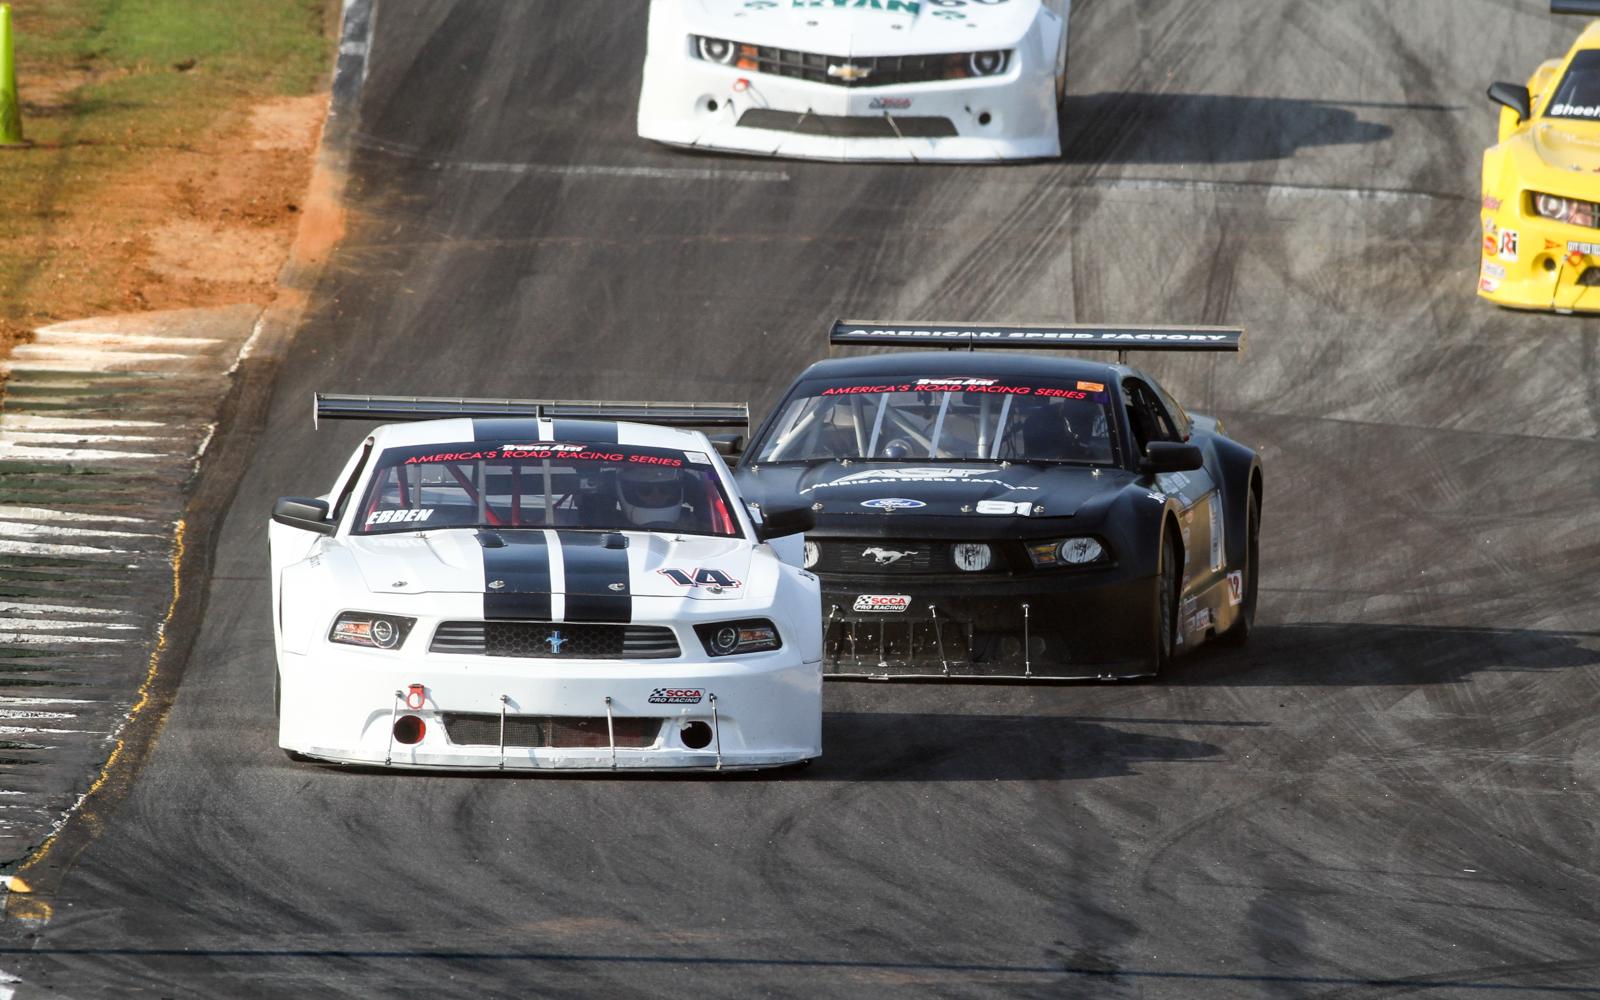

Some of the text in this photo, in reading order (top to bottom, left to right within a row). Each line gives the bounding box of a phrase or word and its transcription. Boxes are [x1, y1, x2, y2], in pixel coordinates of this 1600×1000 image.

[849, 330, 1002, 338] AMERICAN
[1101, 333, 1227, 341] FACTORY
[822, 384, 1087, 399] AMERICA'S ROAD RACING SERIES
[404, 450, 682, 467] AMERICA'S ROAD RACING SERIES
[976, 500, 1033, 517] 81
[657, 568, 742, 588] 14
[871, 597, 906, 605] SCCA
[666, 689, 701, 697] SCCA
